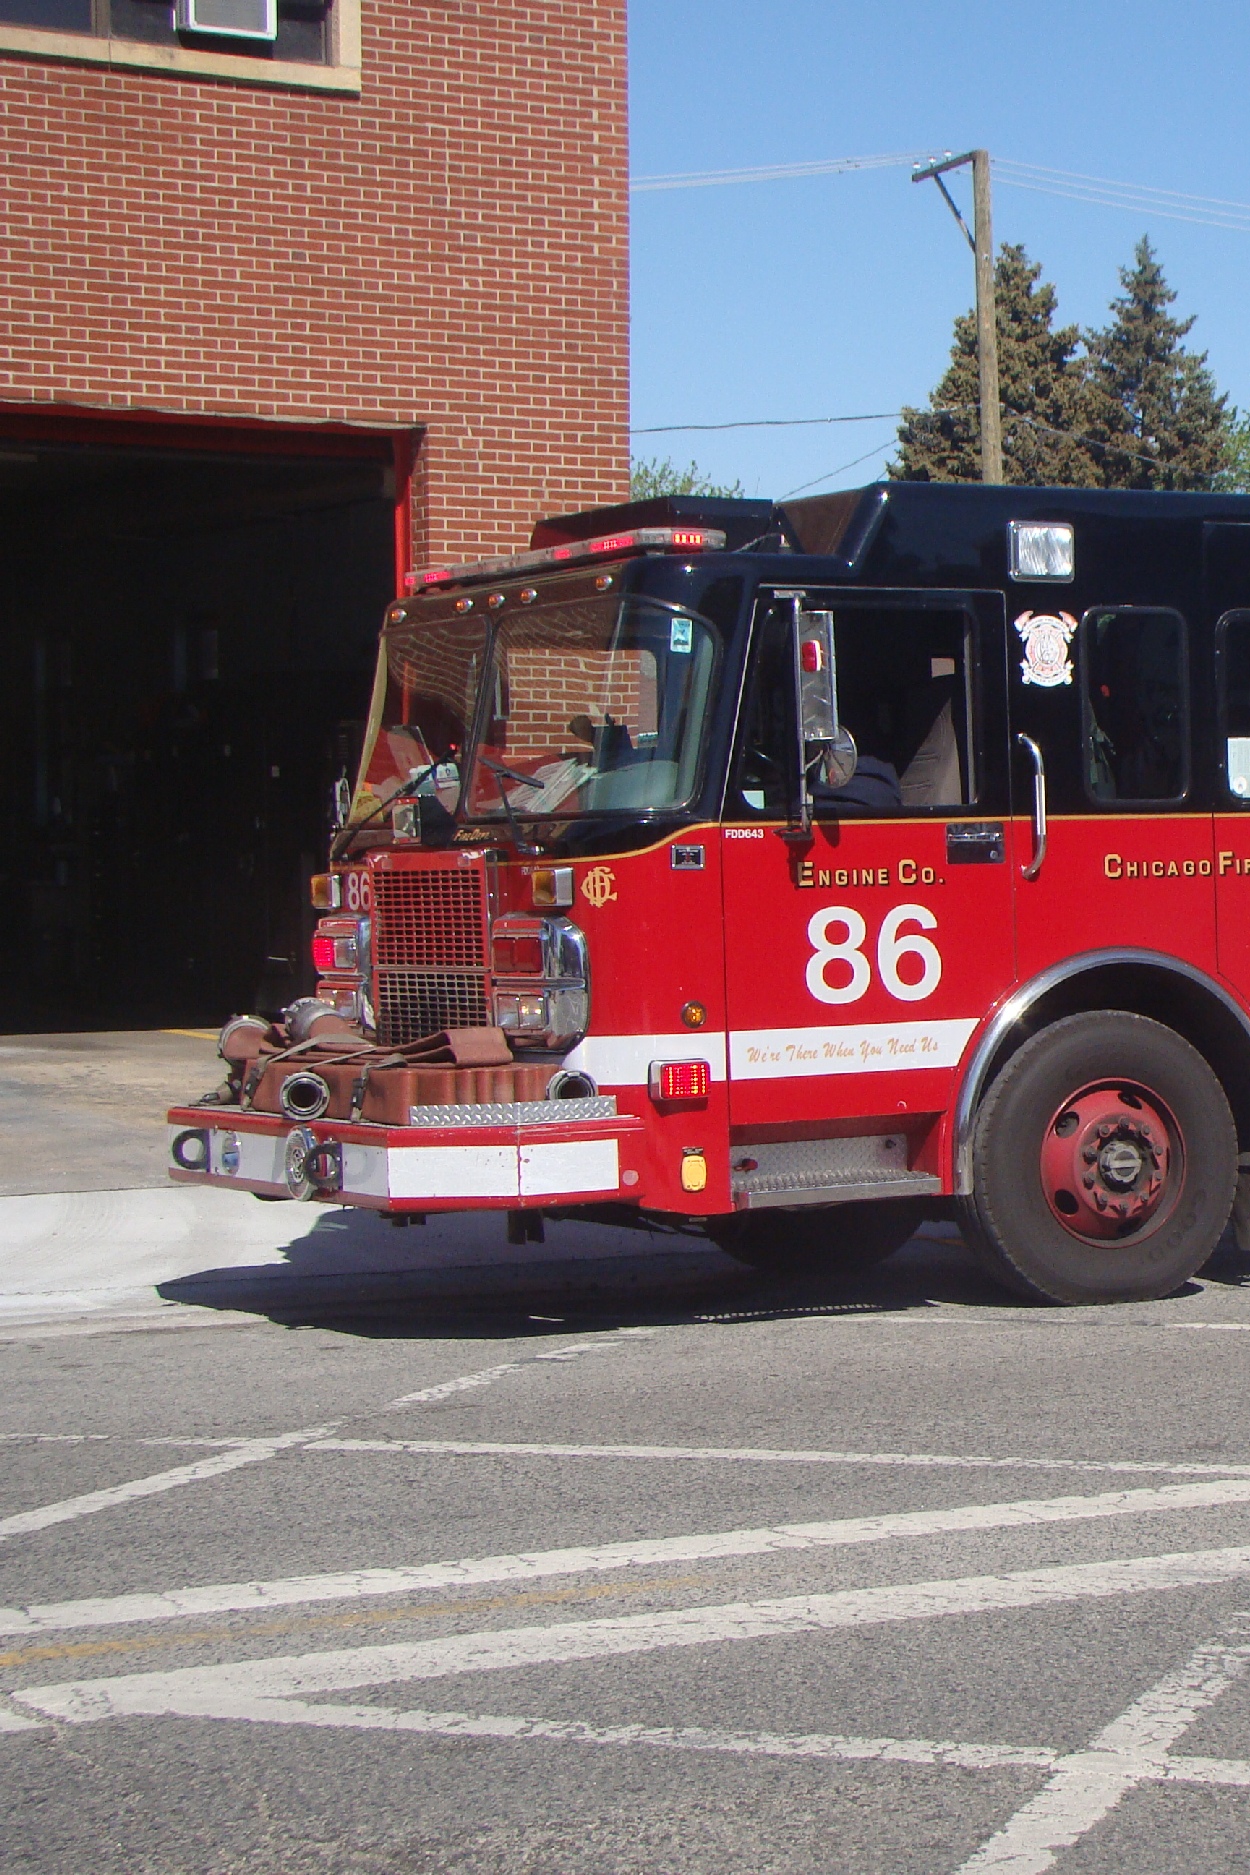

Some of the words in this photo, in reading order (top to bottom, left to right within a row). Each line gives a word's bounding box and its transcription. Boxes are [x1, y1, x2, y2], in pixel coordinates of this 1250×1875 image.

[725, 828, 764, 839] FDD643
[798, 860, 889, 887] ENGINE
[898, 858, 945, 885] CO.
[1104, 853, 1212, 879] CHICAGO
[347, 871, 371, 911] 86
[805, 903, 942, 1005] 86
[746, 1045, 781, 1063] We're
[785, 1043, 819, 1061] There
[823, 1041, 854, 1059] When
[859, 1039, 882, 1063] You
[887, 1036, 917, 1055] Need
[920, 1035, 939, 1053] Us
